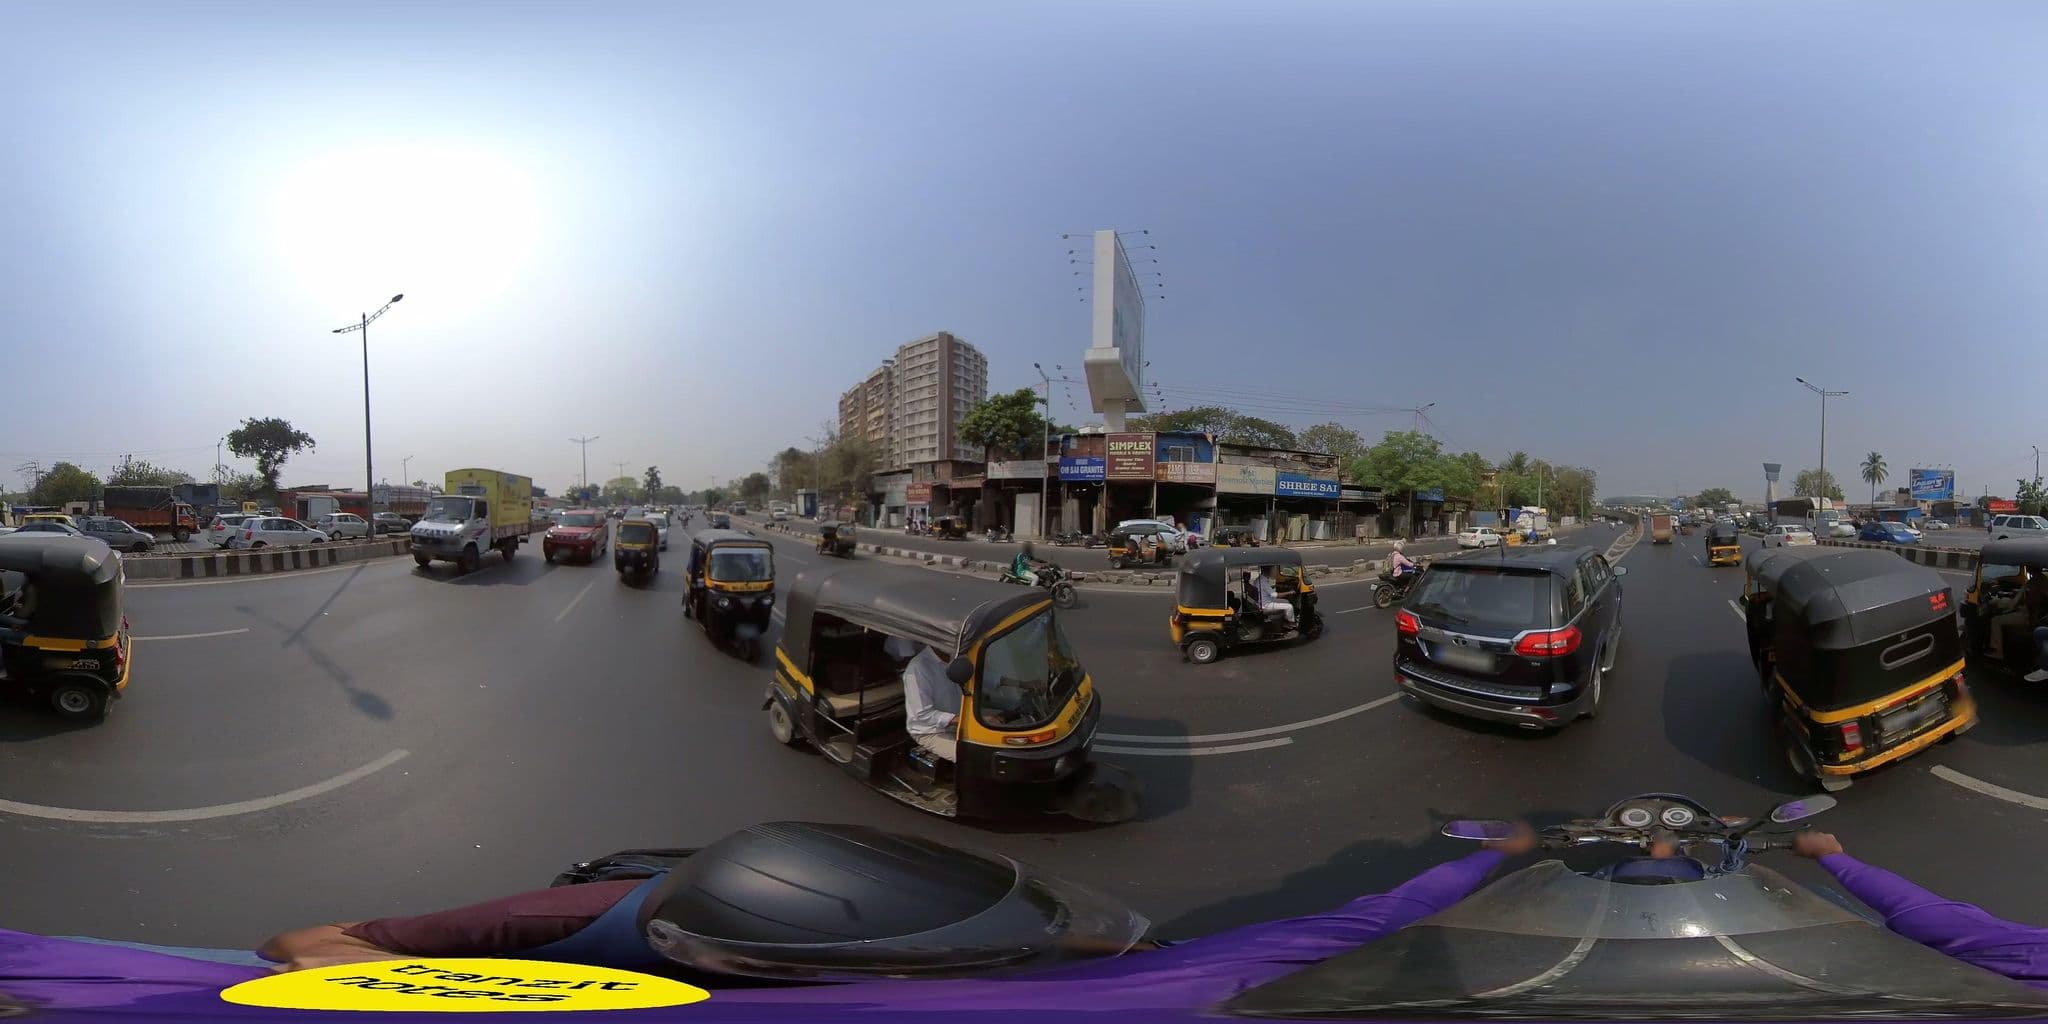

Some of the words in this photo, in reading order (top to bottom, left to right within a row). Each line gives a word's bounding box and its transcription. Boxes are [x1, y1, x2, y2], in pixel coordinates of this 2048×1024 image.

[1109, 441, 1152, 451] SIMPLEX
[1080, 465, 1104, 475] GRANITE
[1279, 481, 1318, 491] SHREE
[1319, 483, 1338, 493] SAI
